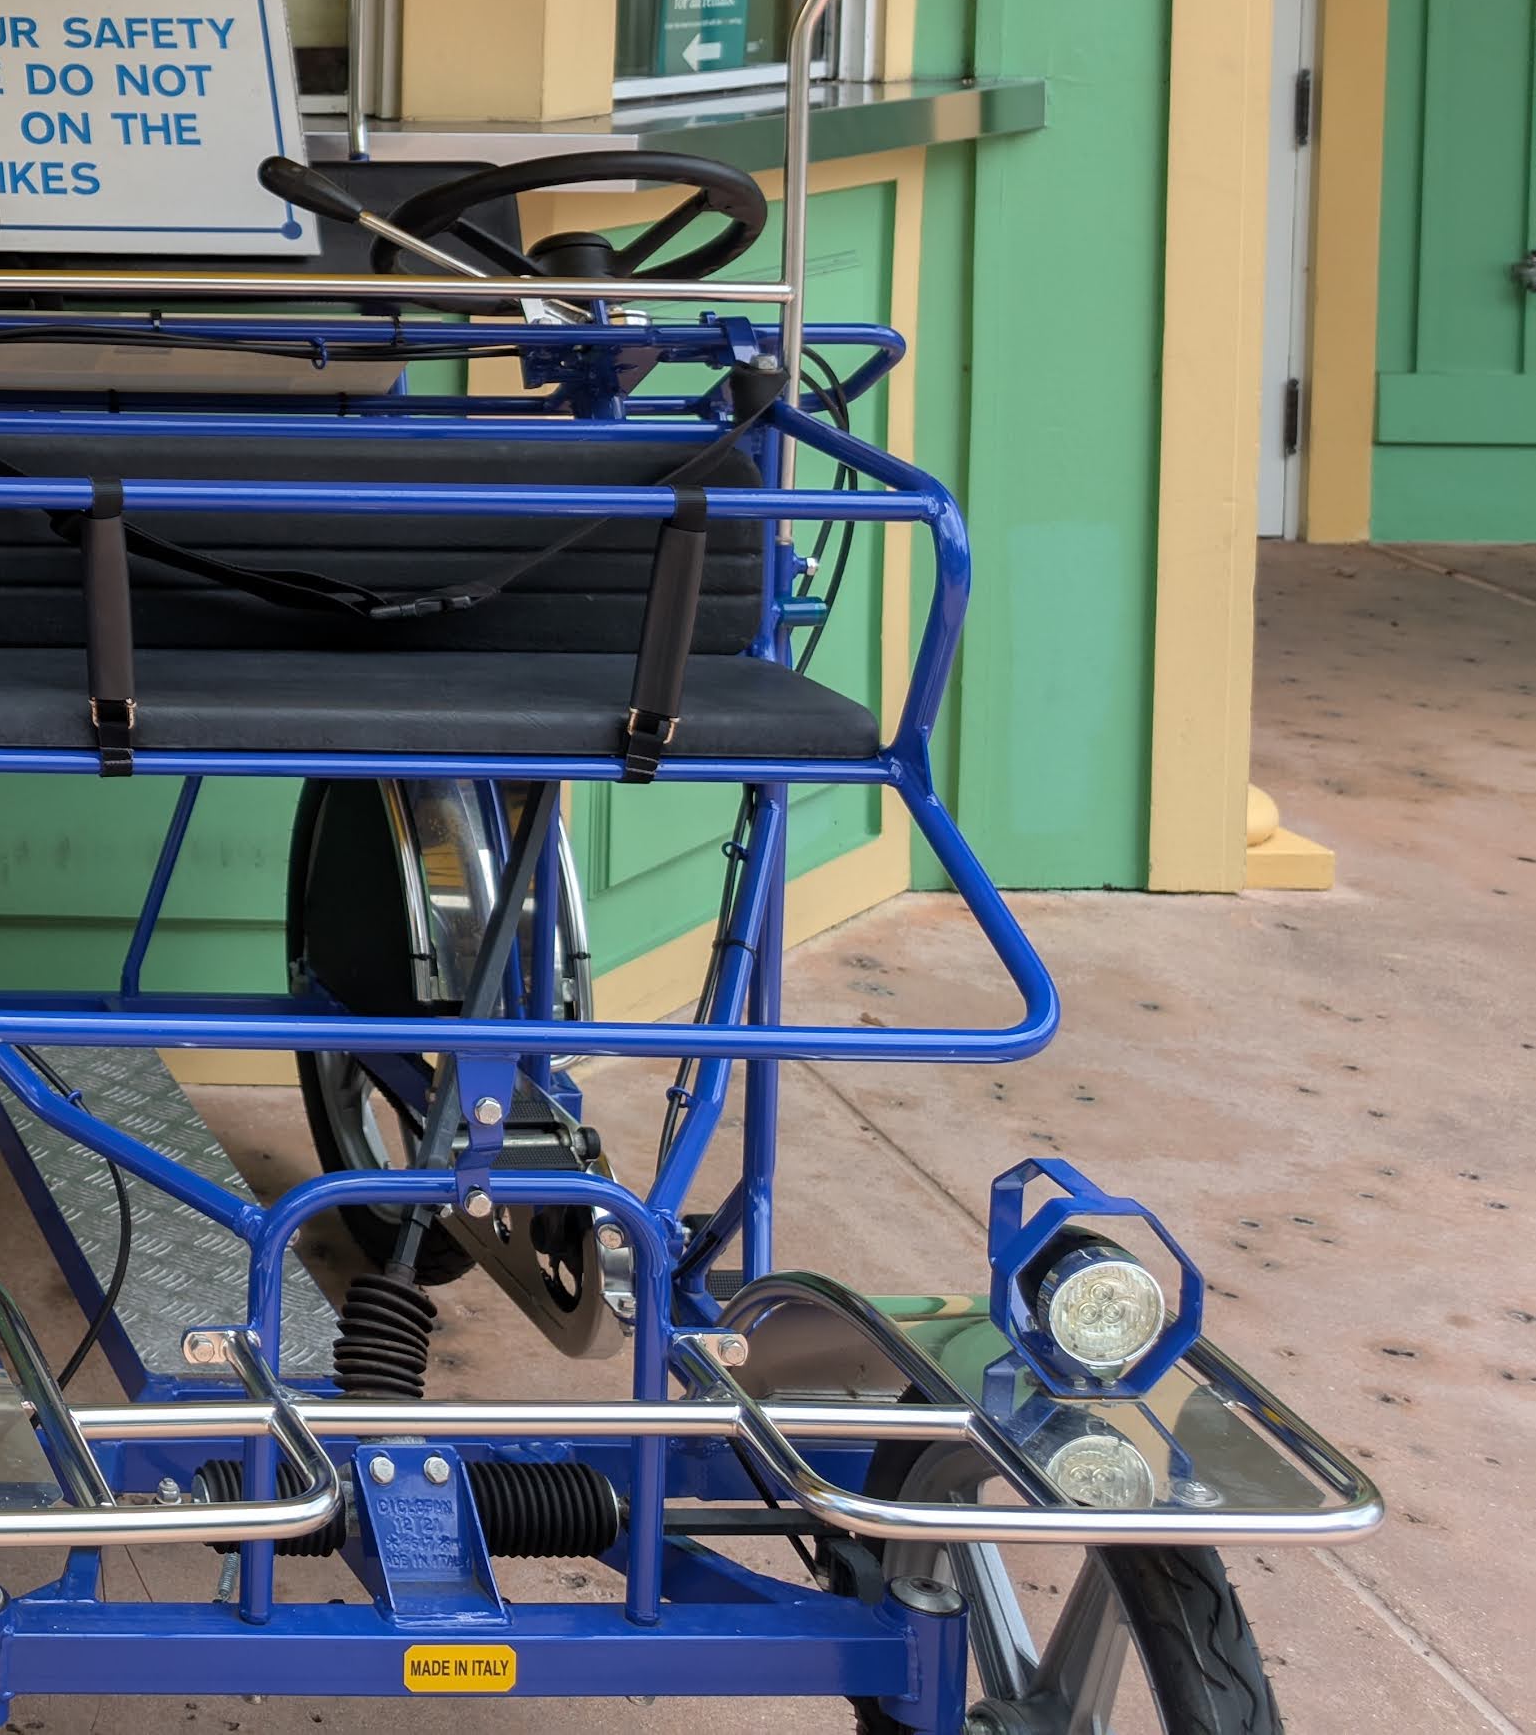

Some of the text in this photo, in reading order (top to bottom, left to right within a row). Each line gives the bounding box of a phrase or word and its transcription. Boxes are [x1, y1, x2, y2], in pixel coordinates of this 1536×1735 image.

[63, 17, 234, 50] SAFETY
[25, 63, 95, 97] DO
[116, 64, 212, 98] NOT
[20, 111, 92, 146] ON
[111, 112, 202, 147] THE
[410, 1660, 509, 1676] MADE IN ITALY
